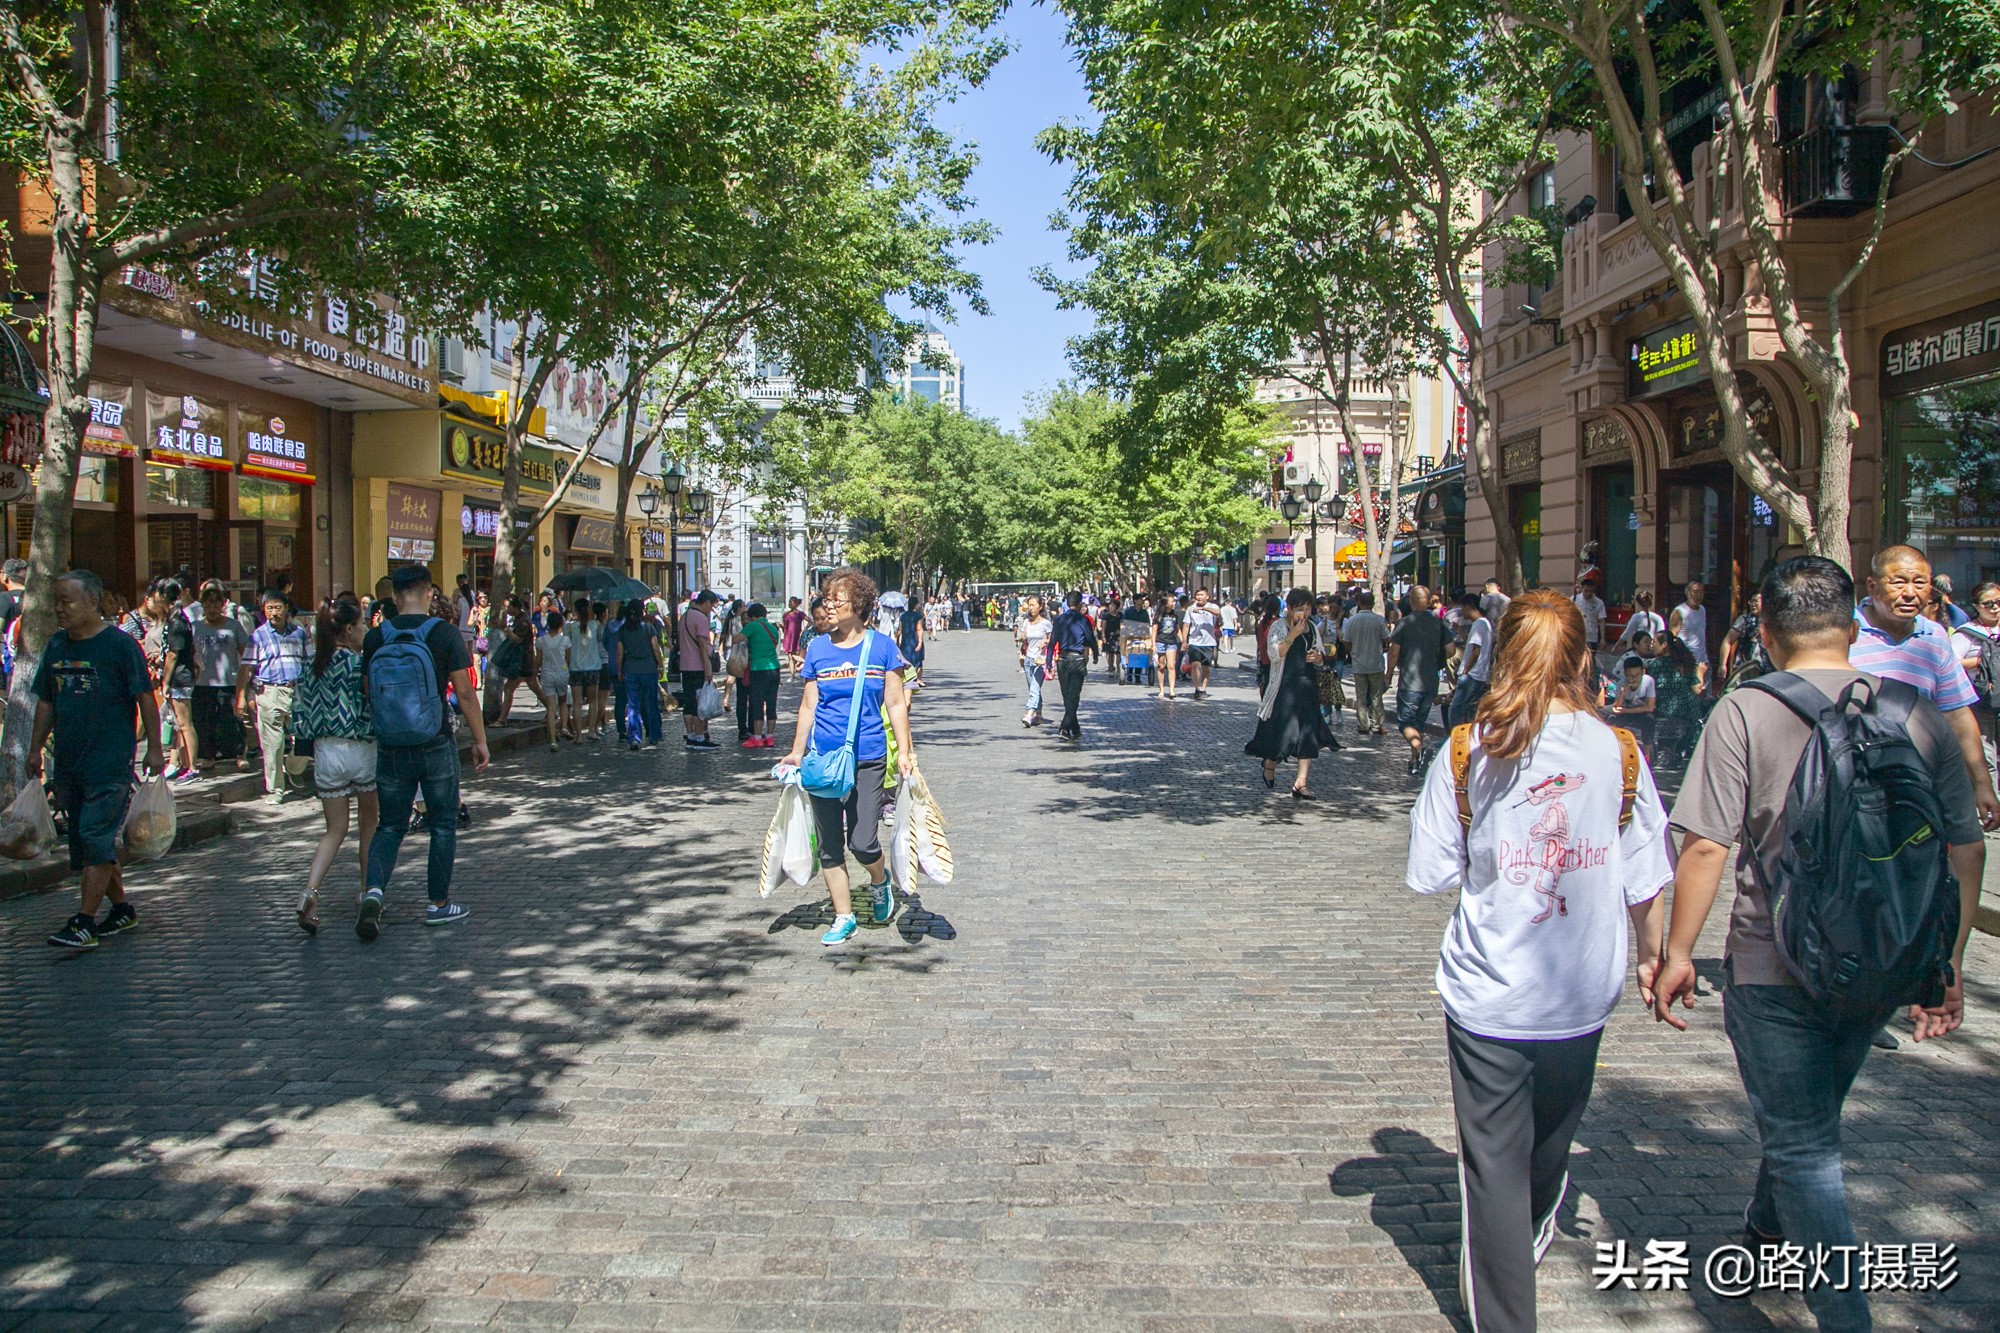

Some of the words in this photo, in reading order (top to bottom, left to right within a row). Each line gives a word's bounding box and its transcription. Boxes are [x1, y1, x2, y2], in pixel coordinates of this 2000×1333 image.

[280, 330, 298, 349] OF
[304, 337, 337, 362] FOOD
[343, 352, 430, 393] SUPERMARKETS
[158, 425, 222, 457] 东北食品
[248, 432, 305, 459] 哈肉联食品
[1498, 840, 1535, 870] Pink
[1543, 837, 1608, 869] Panther
